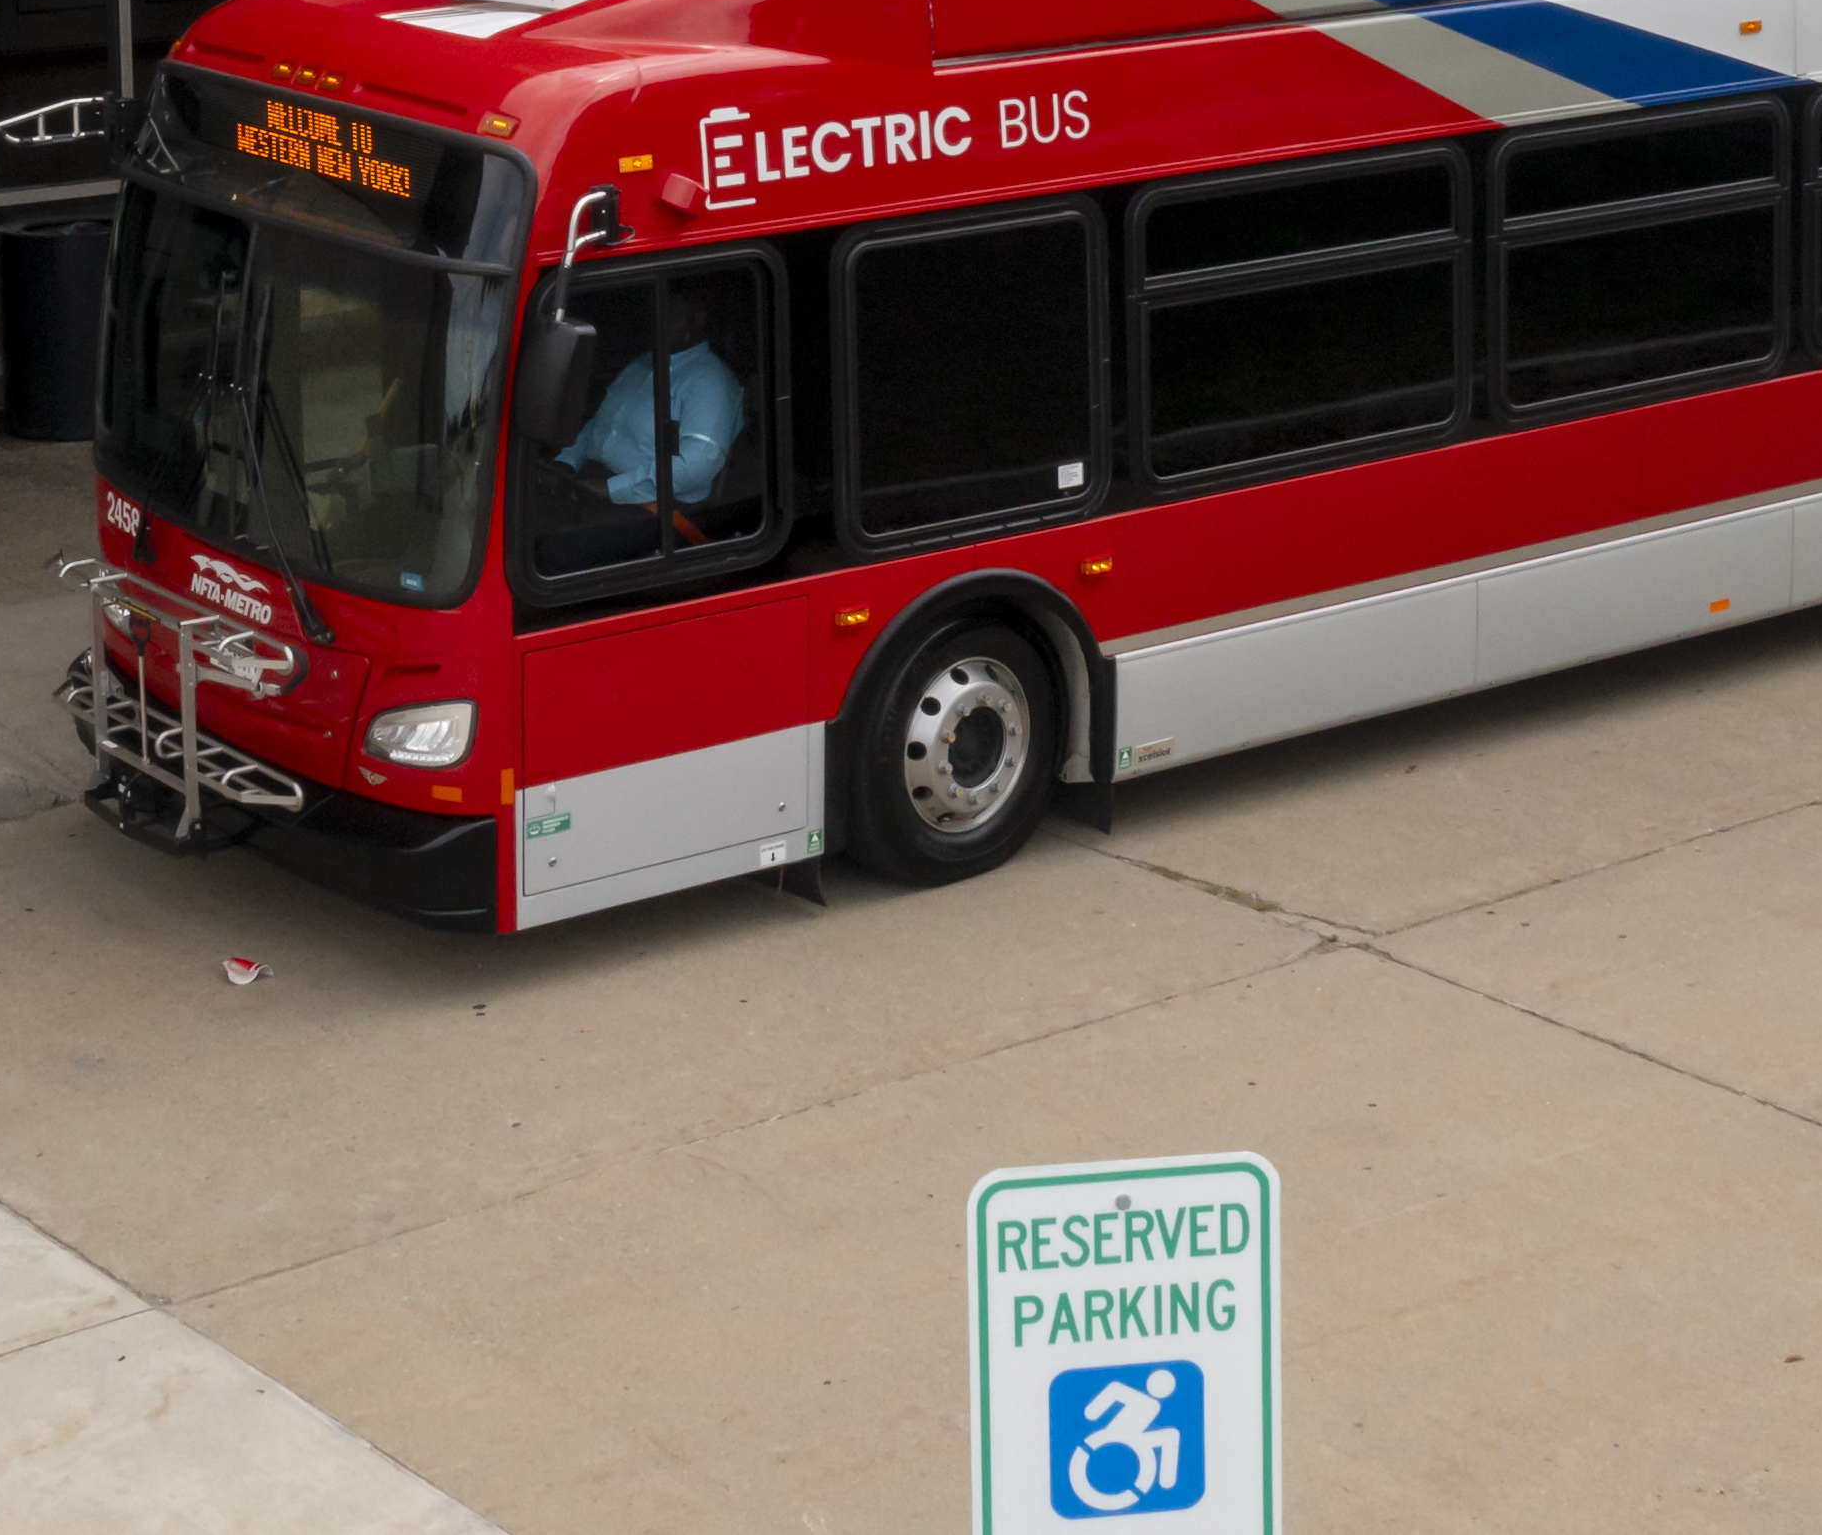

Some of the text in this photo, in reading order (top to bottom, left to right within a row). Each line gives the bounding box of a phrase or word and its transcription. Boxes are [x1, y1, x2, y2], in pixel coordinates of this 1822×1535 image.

[236, 122, 411, 198] WESTERN NEW YORK!
[266, 99, 373, 155] WELCOME TO
[699, 89, 1091, 210] ELECTRIC BUS
[107, 491, 140, 537] 2458
[997, 1202, 1251, 1273] RESERVED
[1013, 1278, 1237, 1347] PARKING
